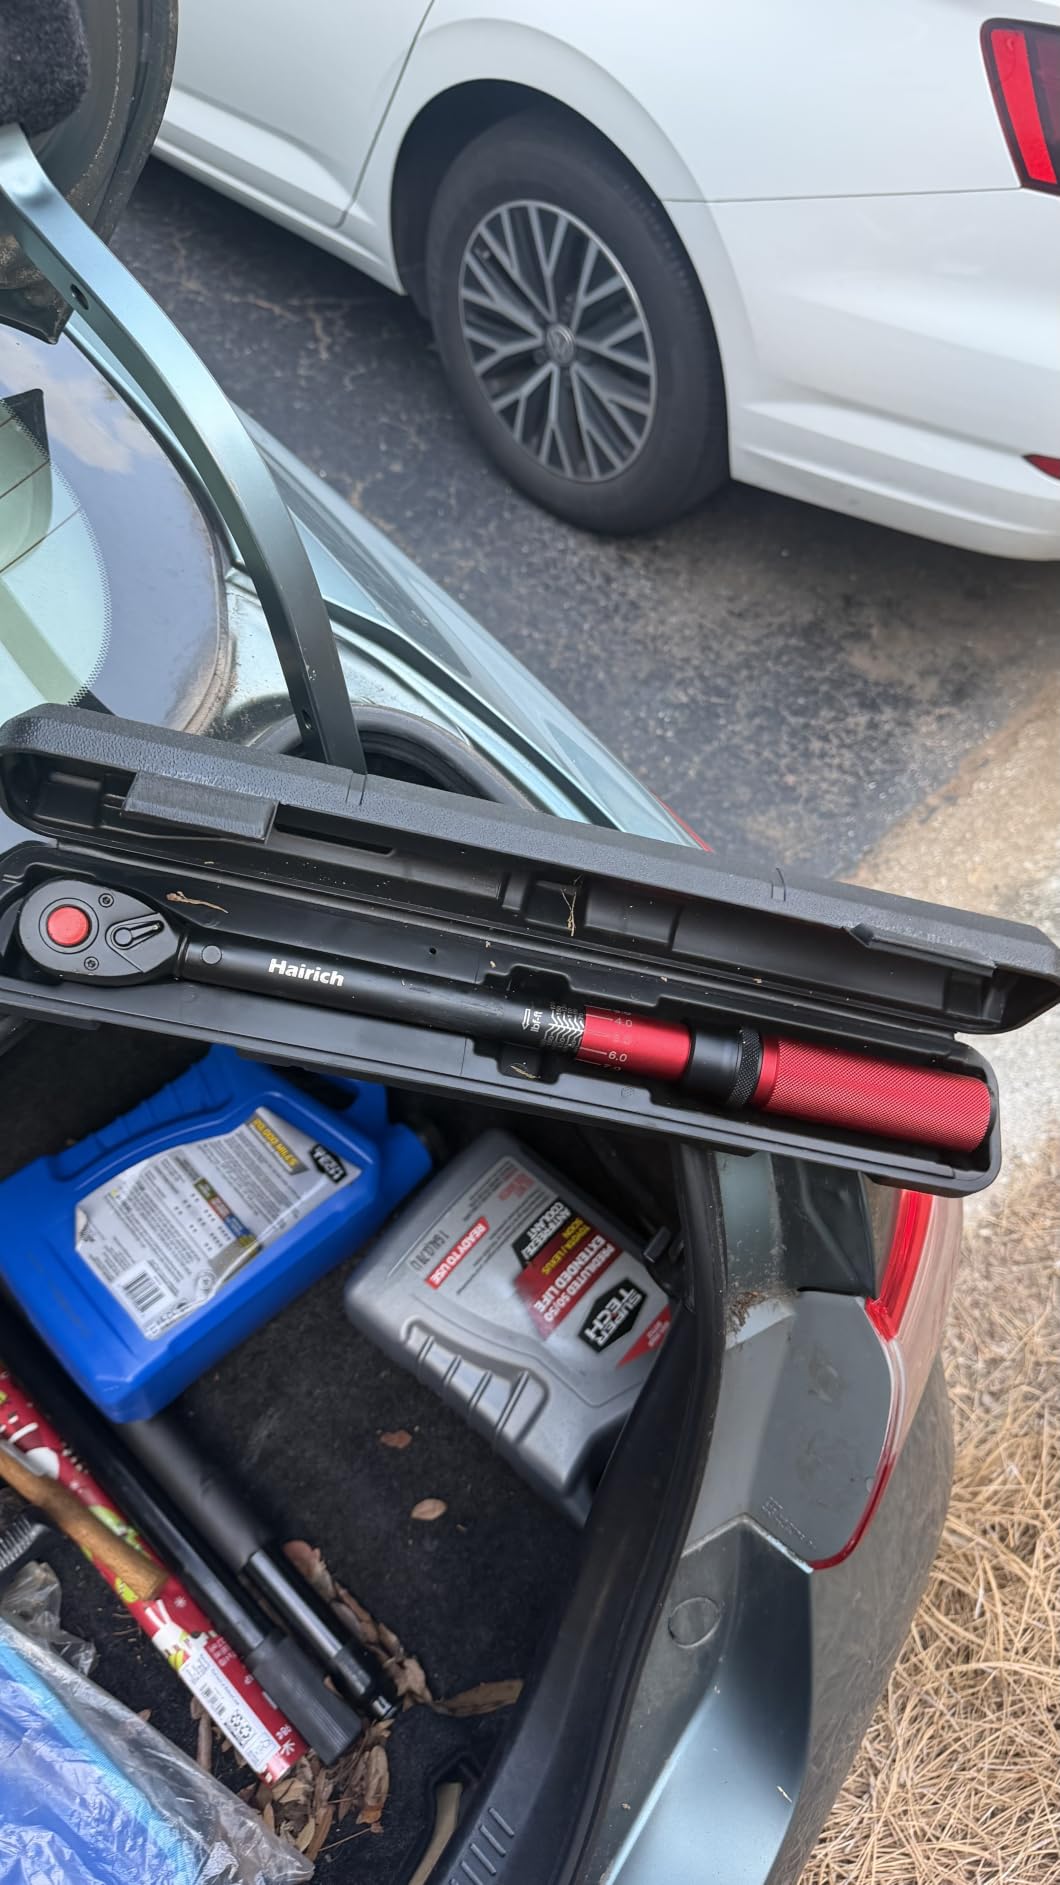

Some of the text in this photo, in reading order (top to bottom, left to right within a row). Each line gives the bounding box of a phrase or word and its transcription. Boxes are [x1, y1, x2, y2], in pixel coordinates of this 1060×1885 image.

[267, 957, 346, 988] Hairich
[614, 1017, 633, 1028] 4.0
[608, 1050, 627, 1062] 6.0
[525, 1200, 563, 1240] COOLANT
[429, 1222, 486, 1285] READY TO USE
[532, 1234, 605, 1313] EXTENDED LIFE
[563, 1242, 615, 1297] PREDILUTED
[582, 1287, 634, 1340] TECH
[592, 1288, 643, 1346] SUPER
